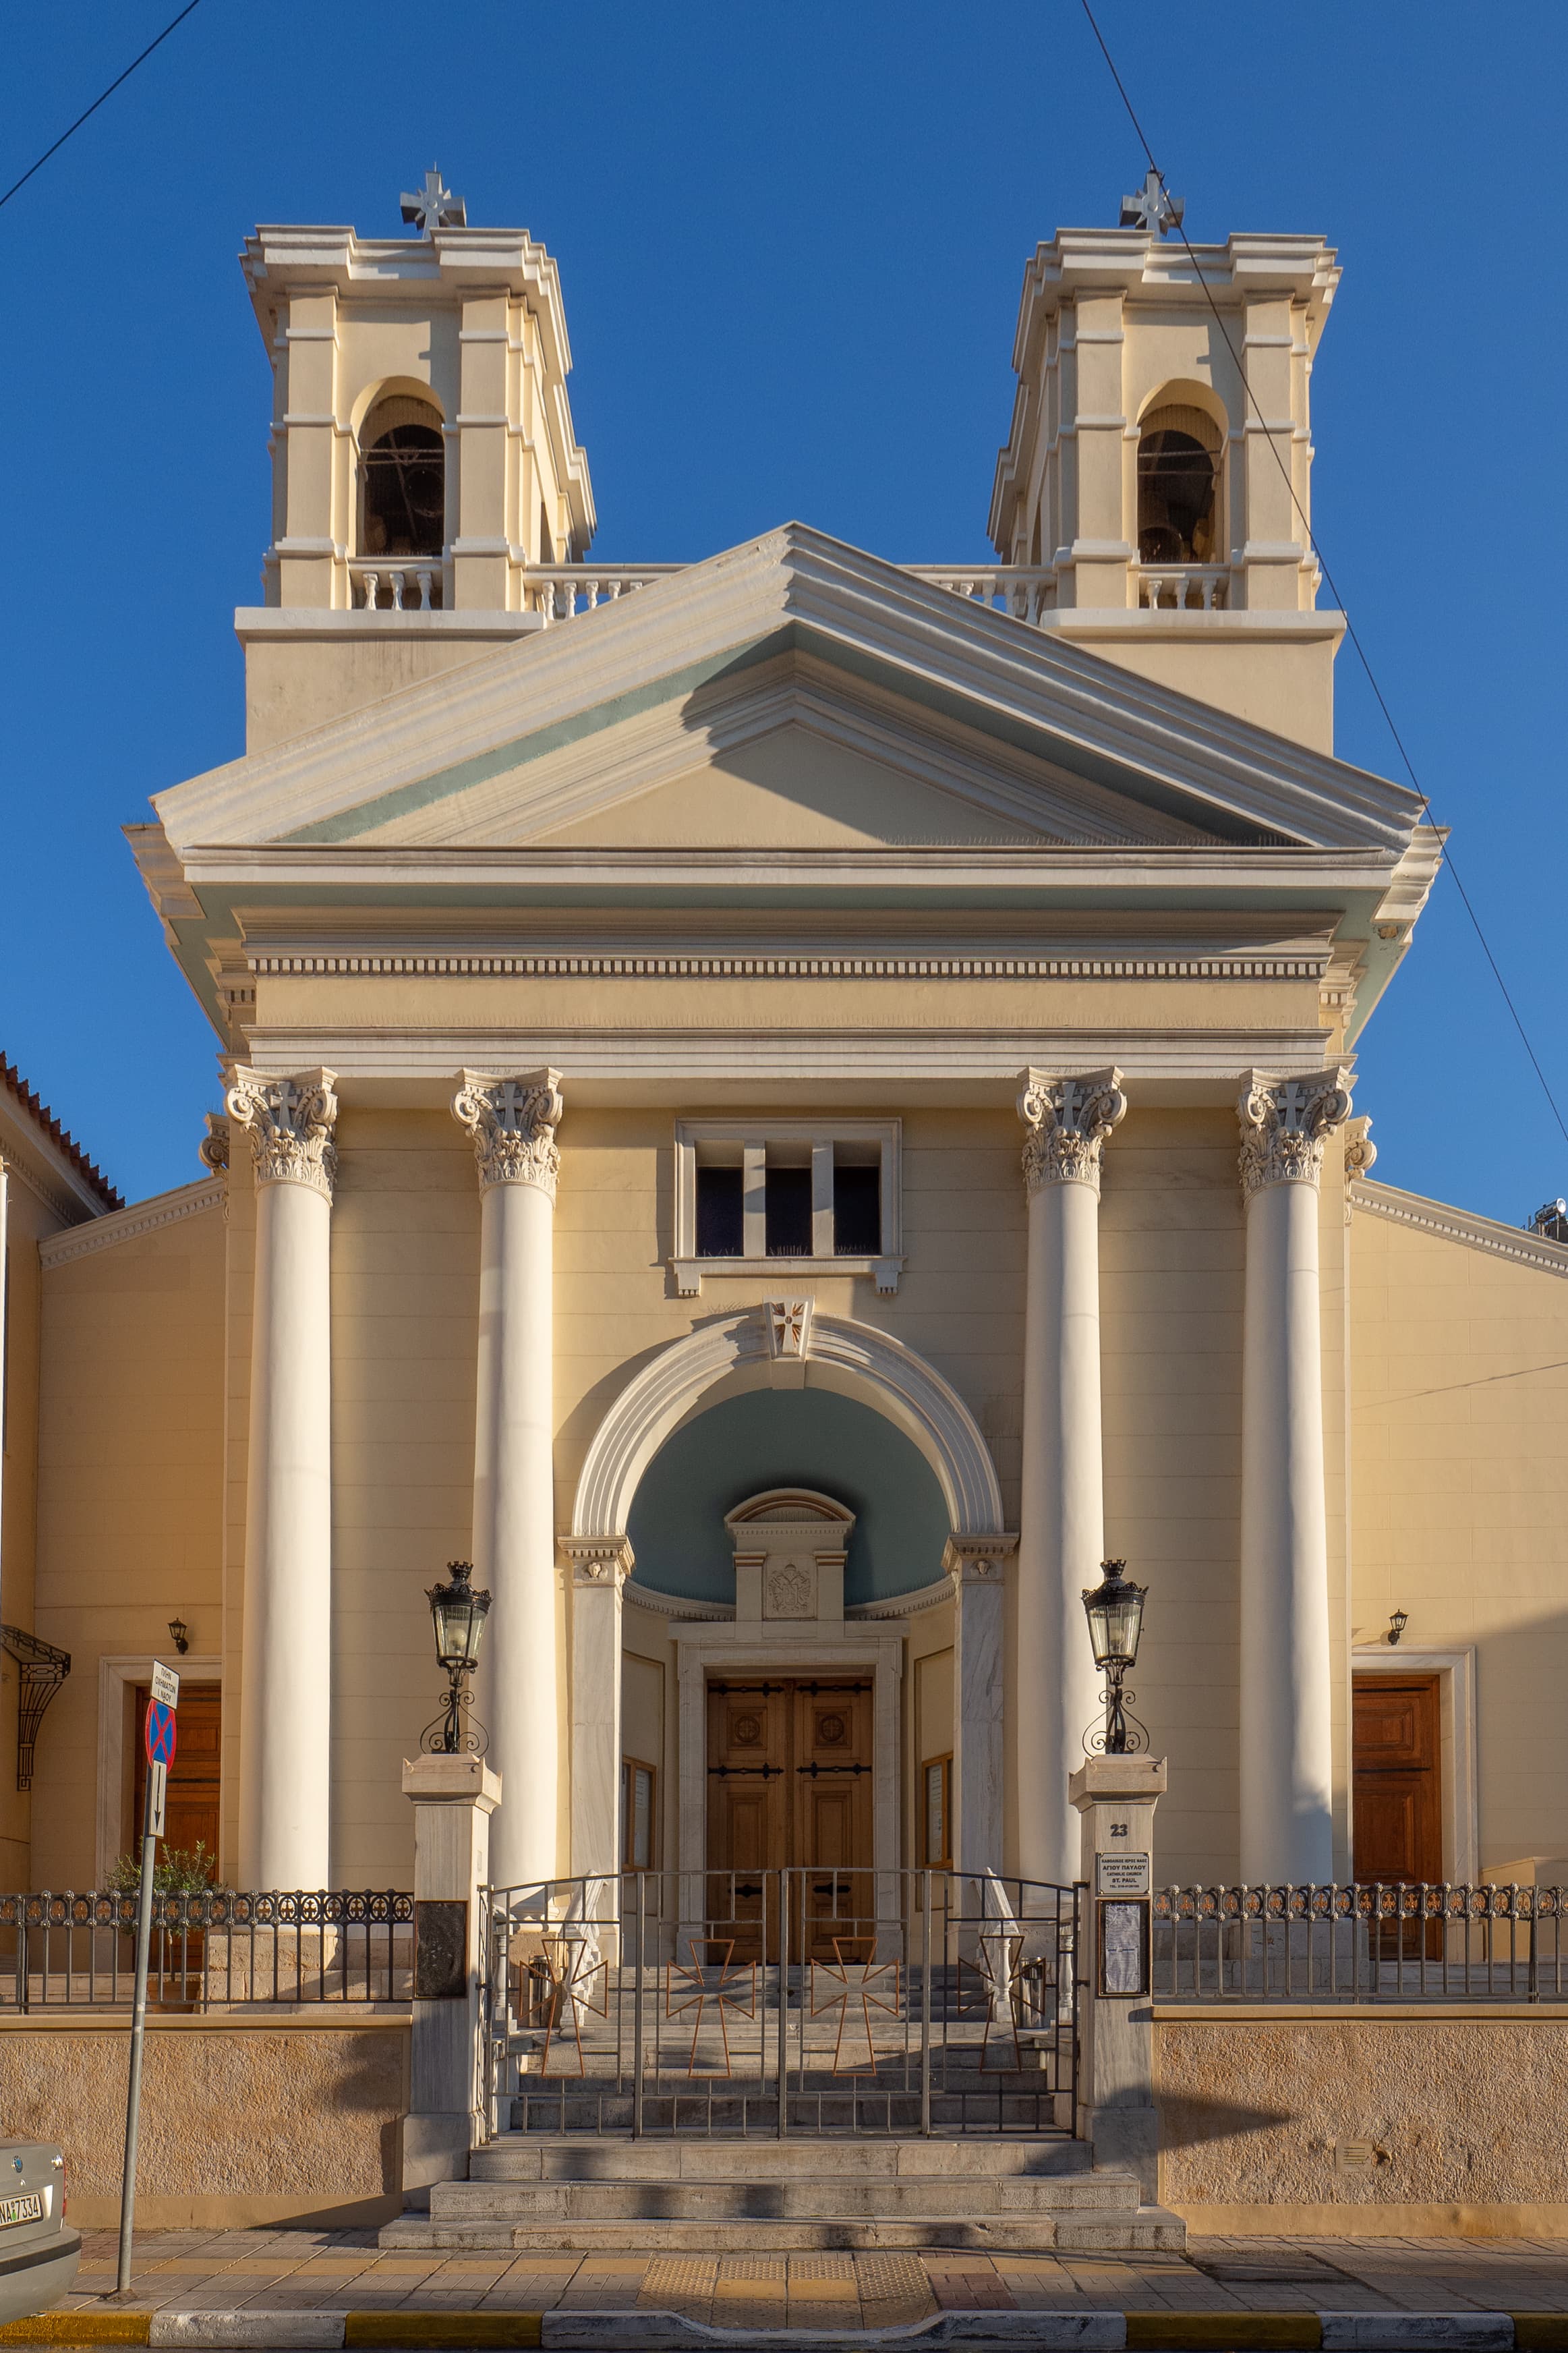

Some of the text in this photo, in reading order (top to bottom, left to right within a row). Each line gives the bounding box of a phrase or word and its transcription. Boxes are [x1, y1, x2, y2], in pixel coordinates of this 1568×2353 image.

[161, 1668, 171, 1680] ΠΛΗΝ
[155, 1676, 175, 1694] ΟΧΗΜΑΤΩΝ
[161, 1691, 171, 1702] ΝΑΟΥ
[1110, 1823, 1128, 1837] 23
[15, 2196, 38, 2220] 7334
